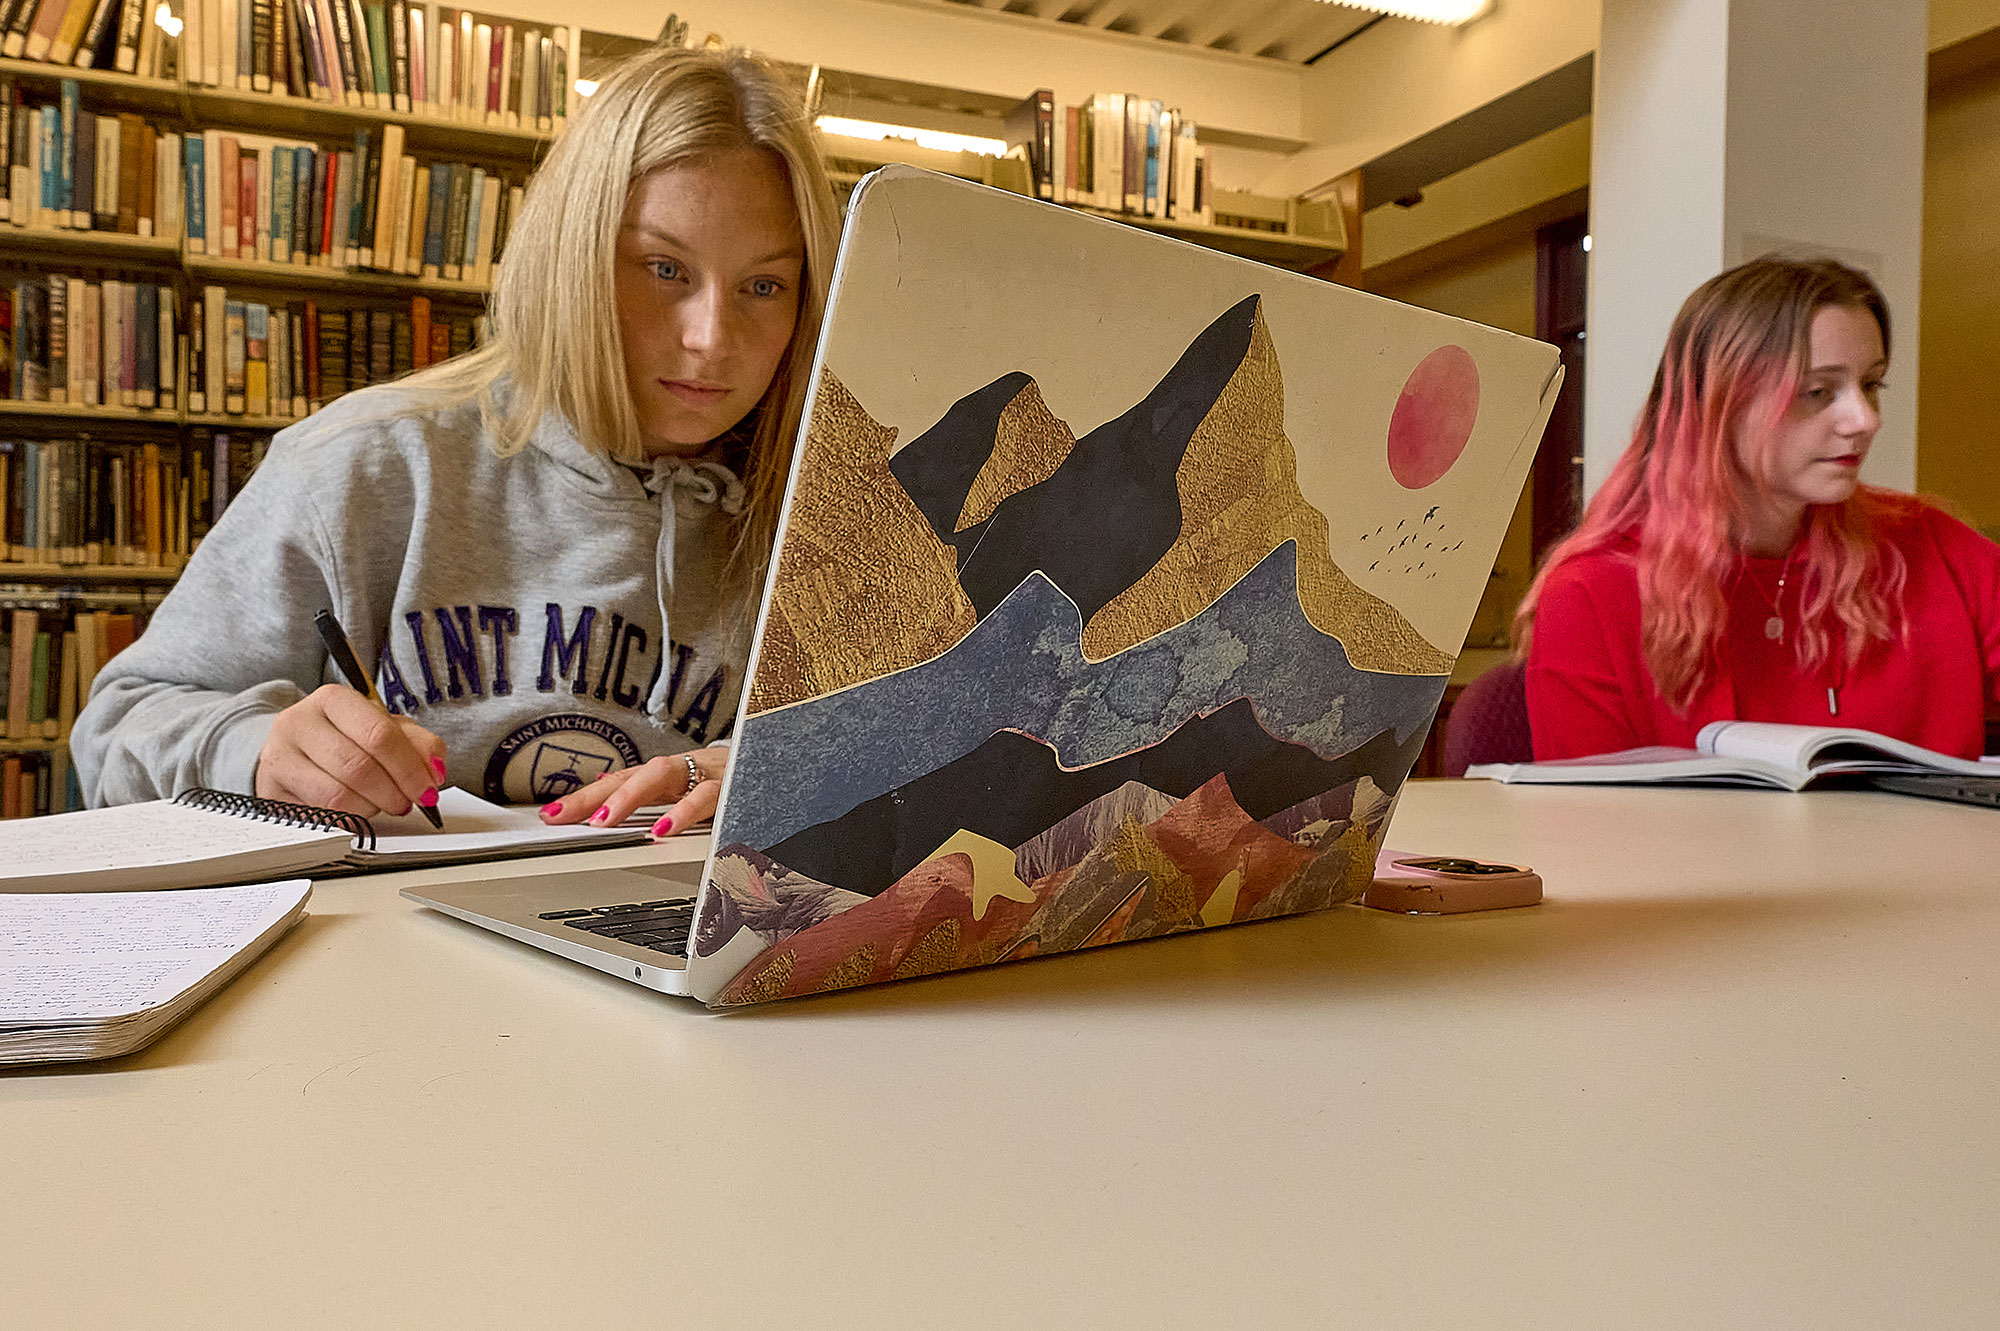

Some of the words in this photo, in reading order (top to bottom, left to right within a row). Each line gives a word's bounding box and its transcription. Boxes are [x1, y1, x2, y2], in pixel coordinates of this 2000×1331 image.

[381, 604, 516, 715] AINT
[537, 603, 735, 744] MICHA
[501, 722, 543, 754] SAINT
